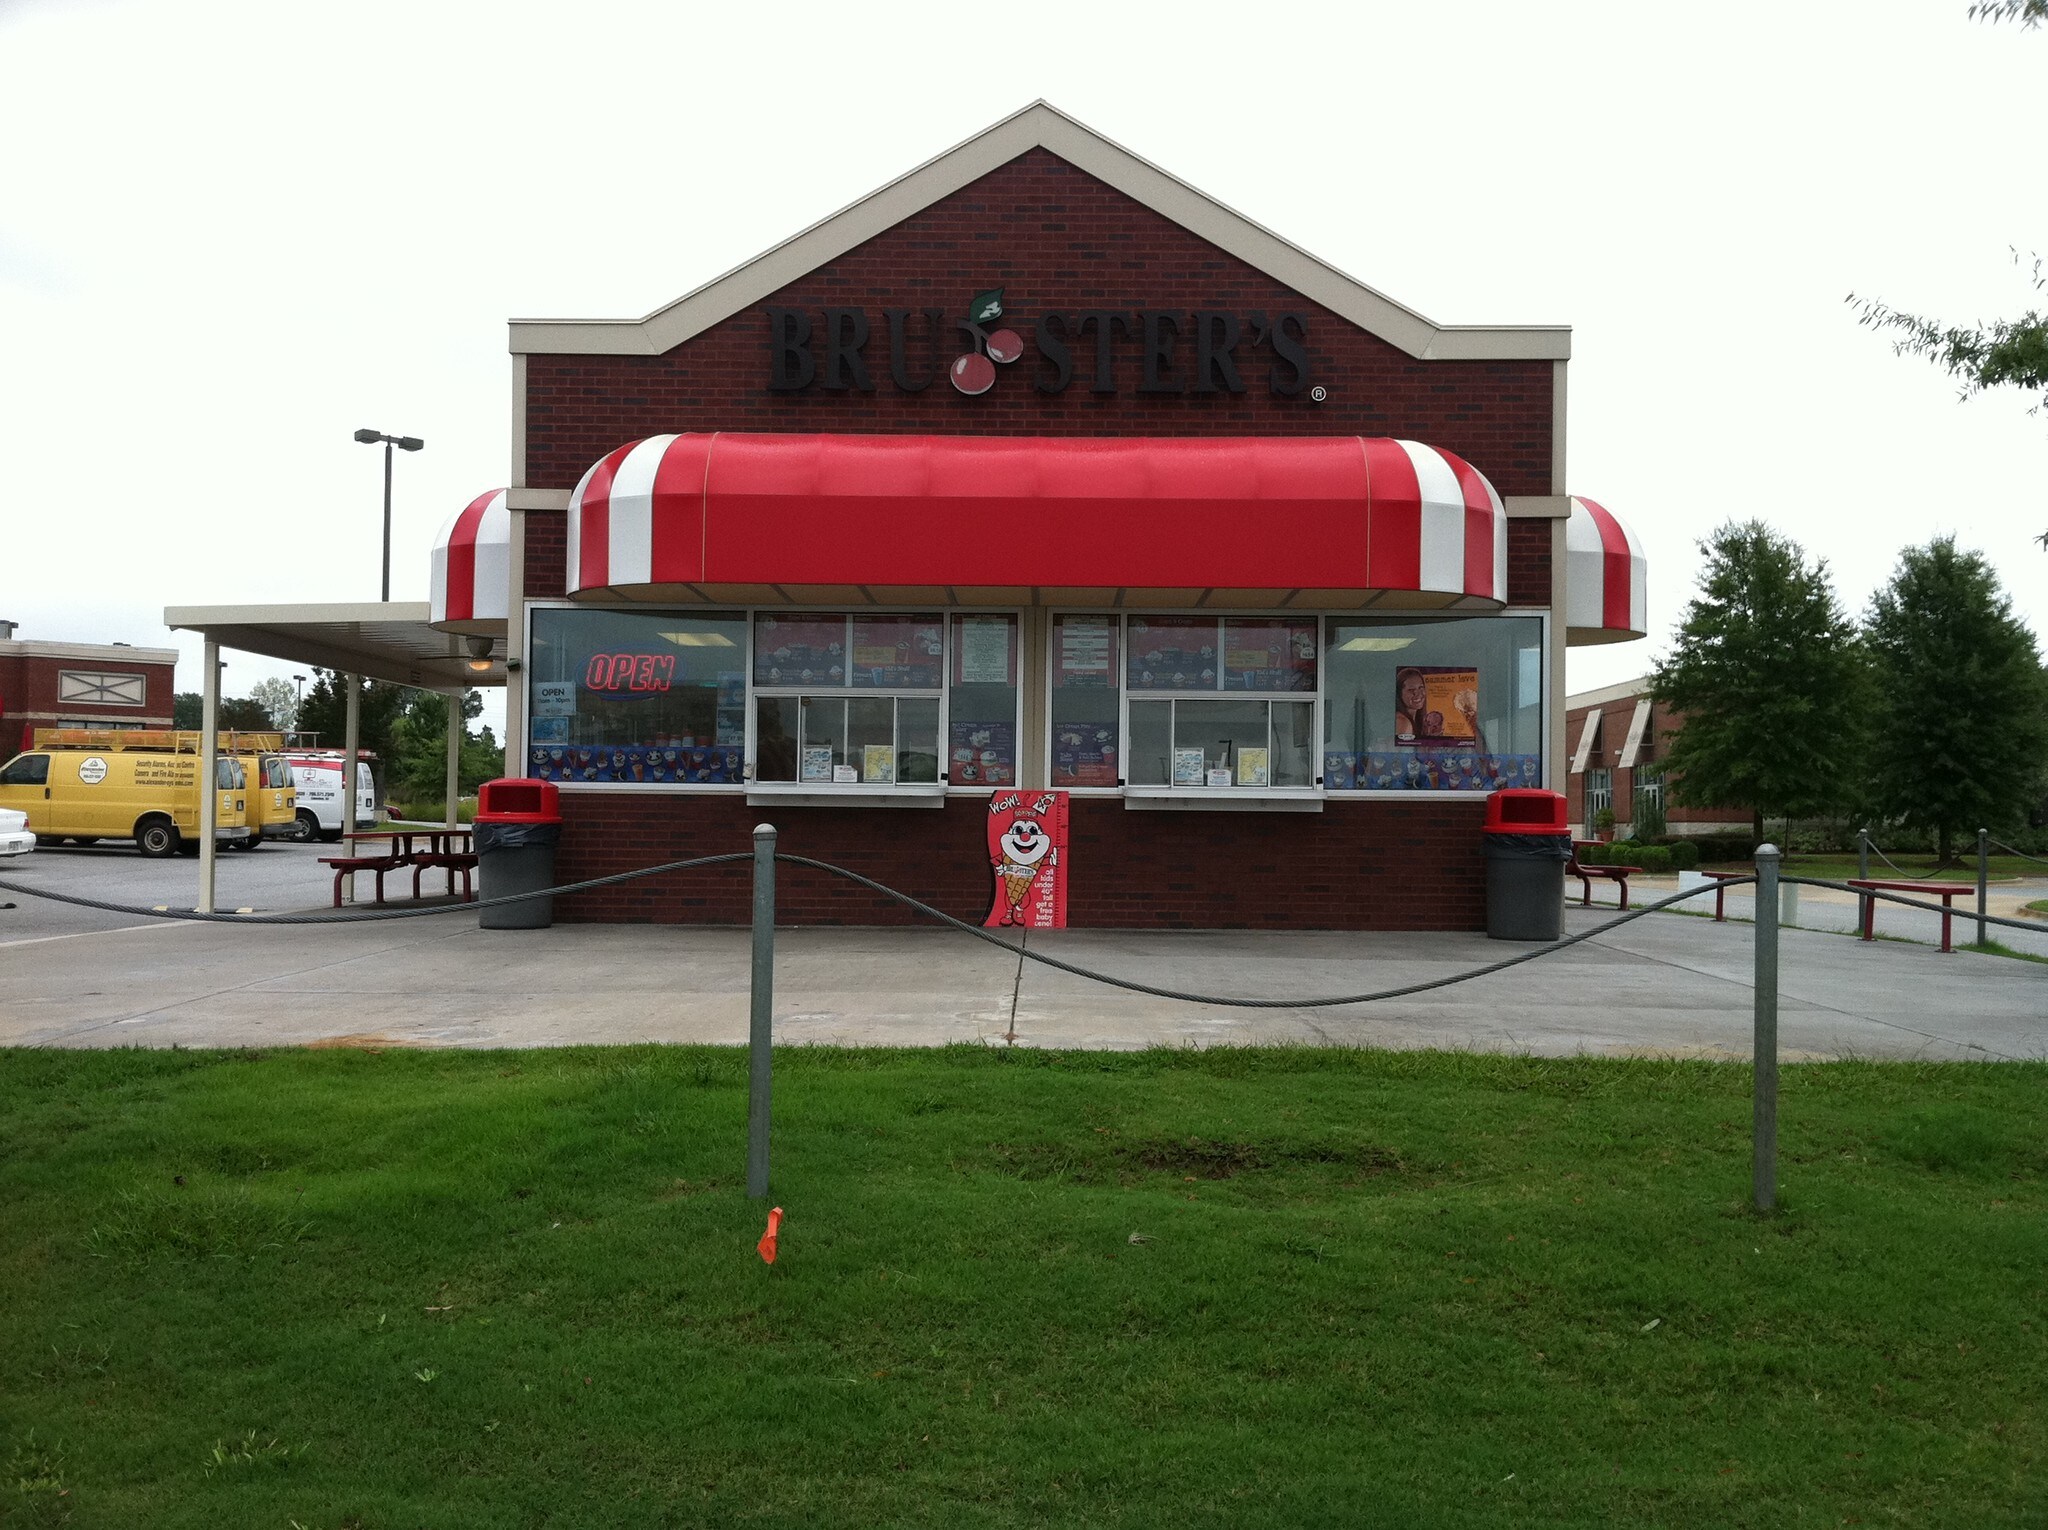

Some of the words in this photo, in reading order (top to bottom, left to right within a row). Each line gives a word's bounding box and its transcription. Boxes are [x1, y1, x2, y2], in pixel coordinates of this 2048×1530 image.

[586, 653, 675, 691] OPEN
[541, 688, 565, 697] OPEN
[1035, 901, 1047, 909] get
[1036, 913, 1053, 922] baby
